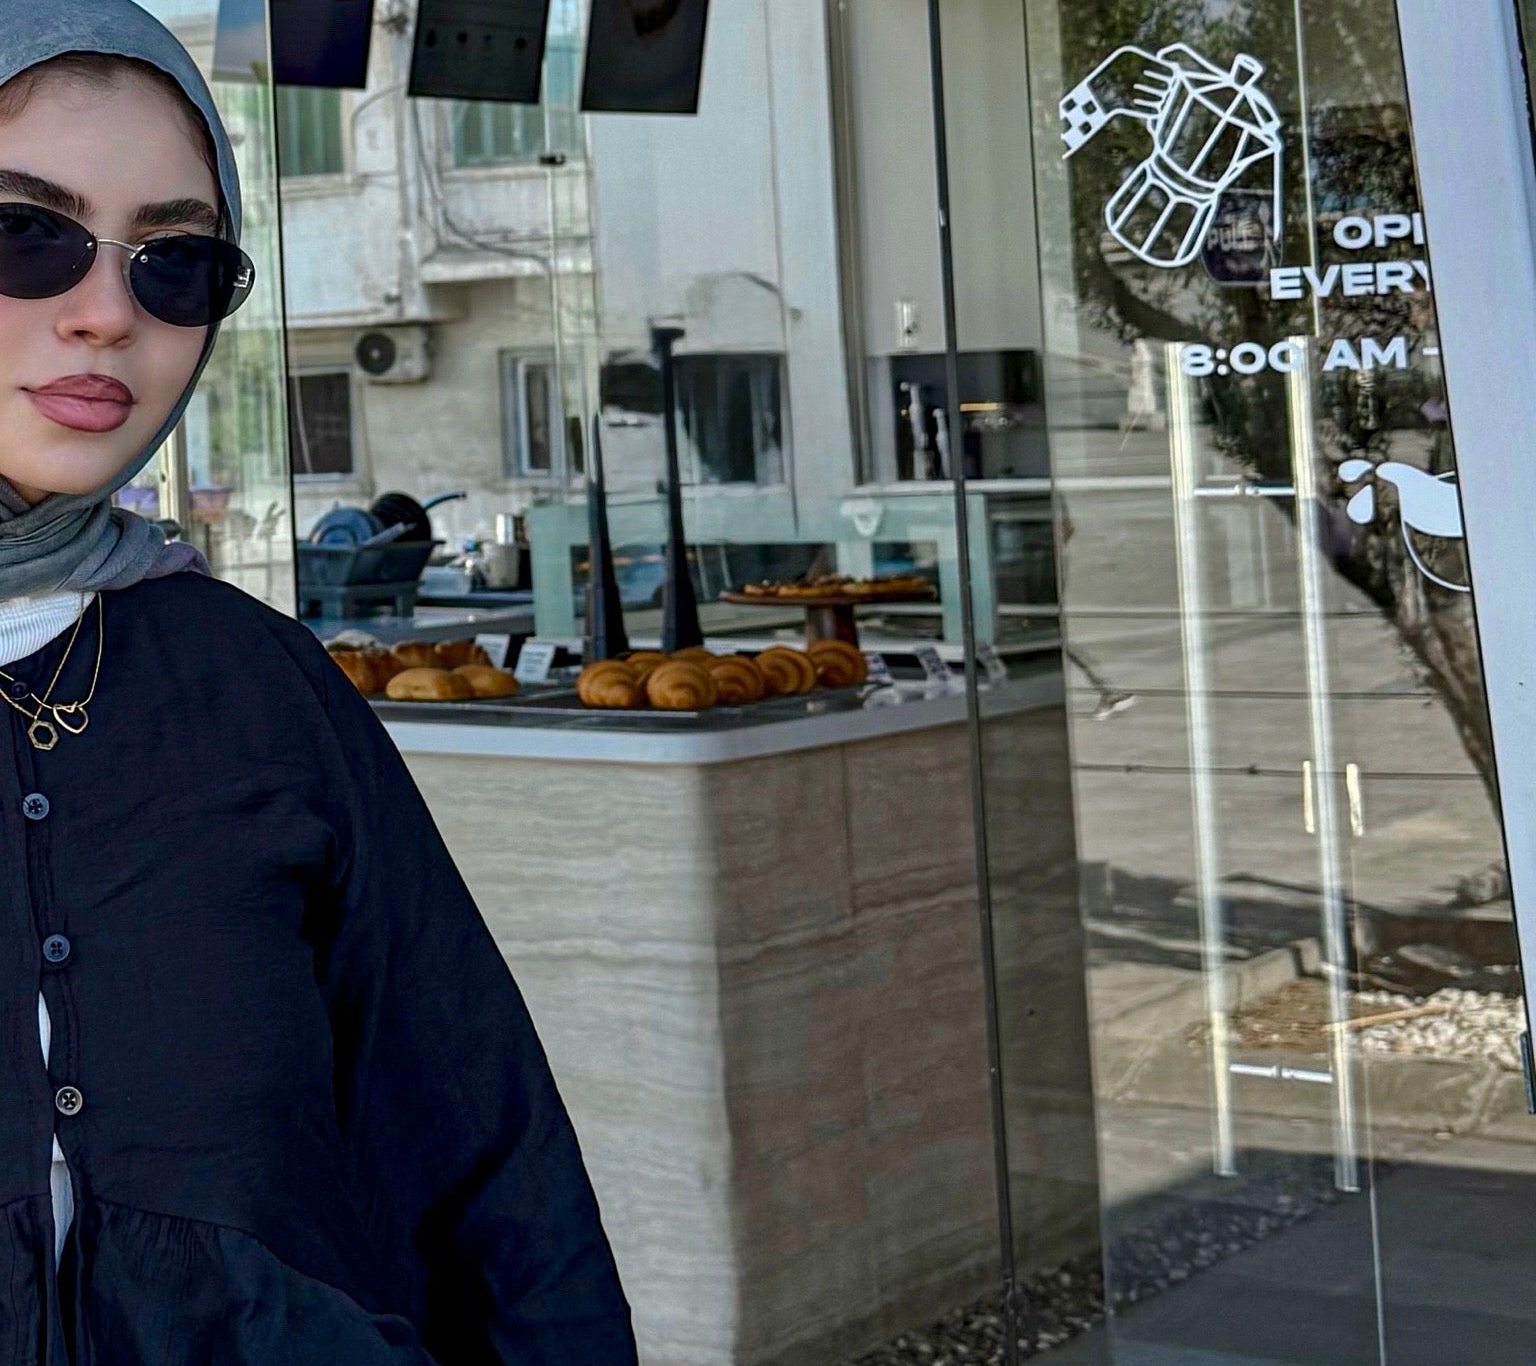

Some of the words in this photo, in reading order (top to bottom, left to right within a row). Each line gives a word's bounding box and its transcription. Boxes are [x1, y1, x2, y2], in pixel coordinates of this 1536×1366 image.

[1332, 212, 1425, 250] OP
[1181, 341, 1304, 376] 8:00
[1322, 337, 1407, 372] AM
